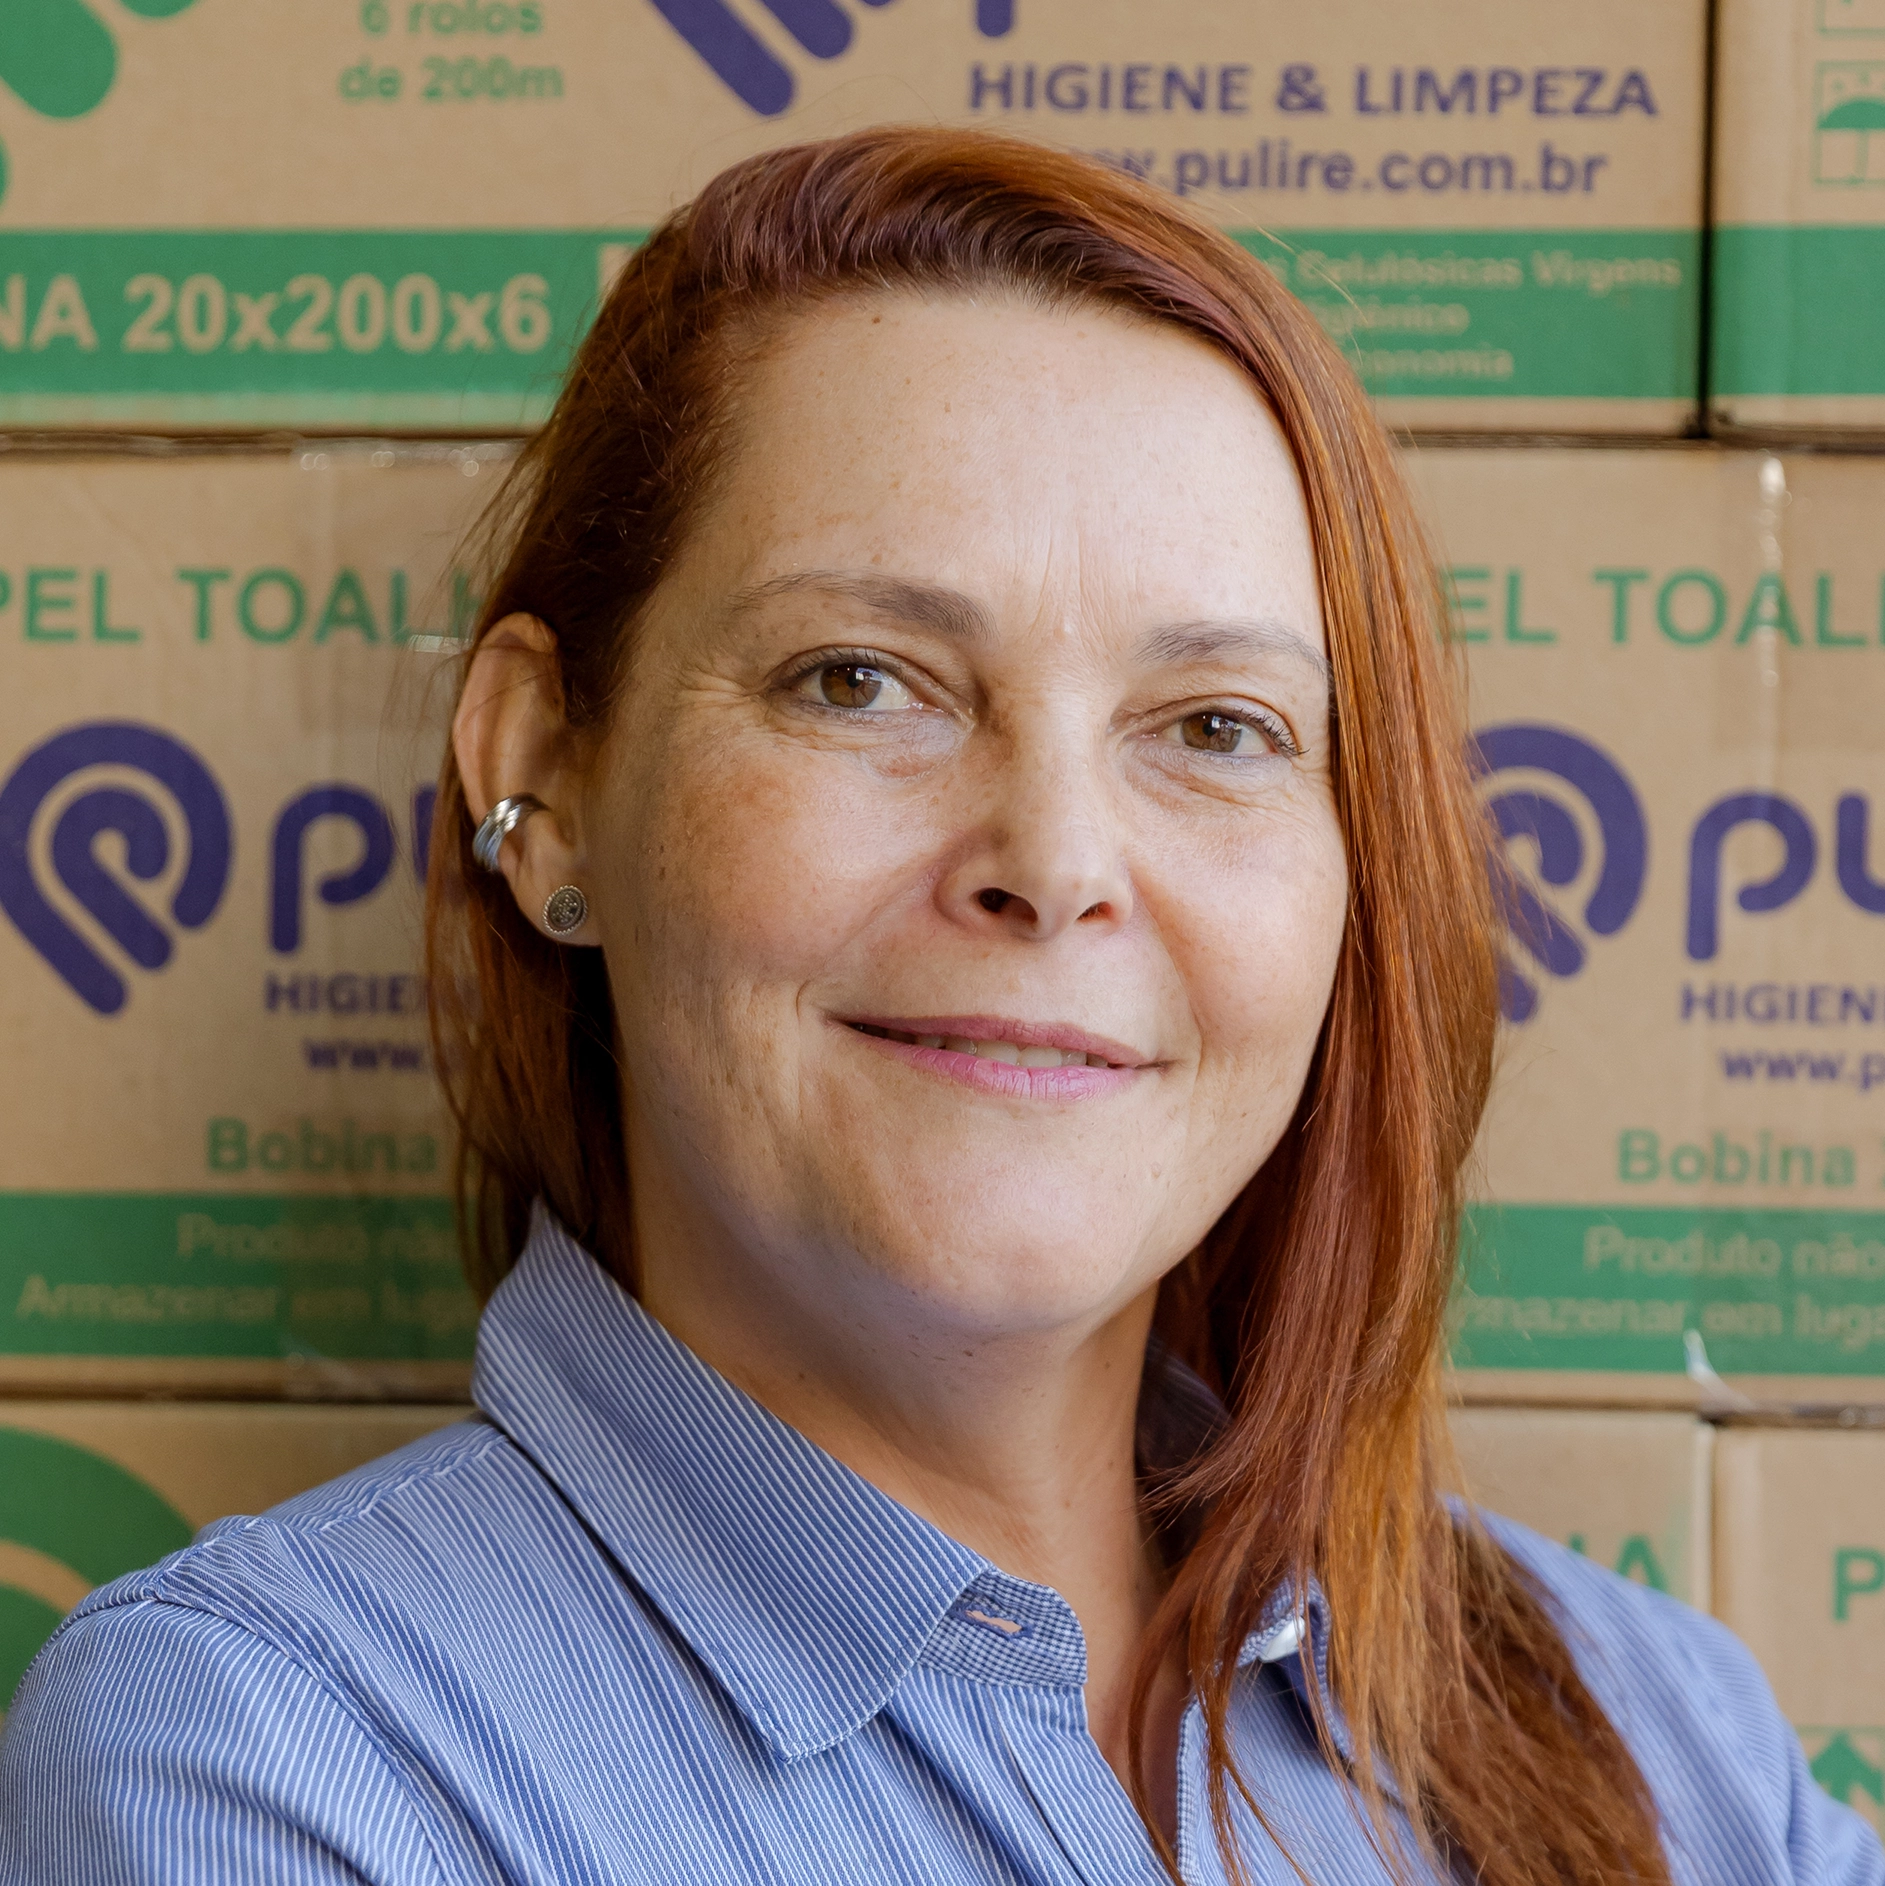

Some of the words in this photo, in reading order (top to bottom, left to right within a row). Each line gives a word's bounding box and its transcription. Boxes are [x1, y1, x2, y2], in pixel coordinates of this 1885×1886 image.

[406, 0, 543, 36] rolos
[338, 55, 400, 99] de
[421, 55, 563, 99] 200m
[969, 62, 1250, 113] HIGIENE
[1277, 63, 1327, 112] &
[1355, 65, 1656, 115] LIMPEZA
[1092, 138, 1608, 195] w.pulire.com.br
[121, 272, 552, 353] 20x200x6
[0, 567, 140, 643] EL
[1592, 568, 1885, 646] TOAL
[206, 1116, 438, 1174] Bobina
[1617, 1127, 1856, 1186] Bobina
[178, 1213, 369, 1262] Produto
[1584, 1226, 1783, 1277] Produto
[15, 1275, 279, 1322] Armazenar
[1703, 1301, 1784, 1336] em
